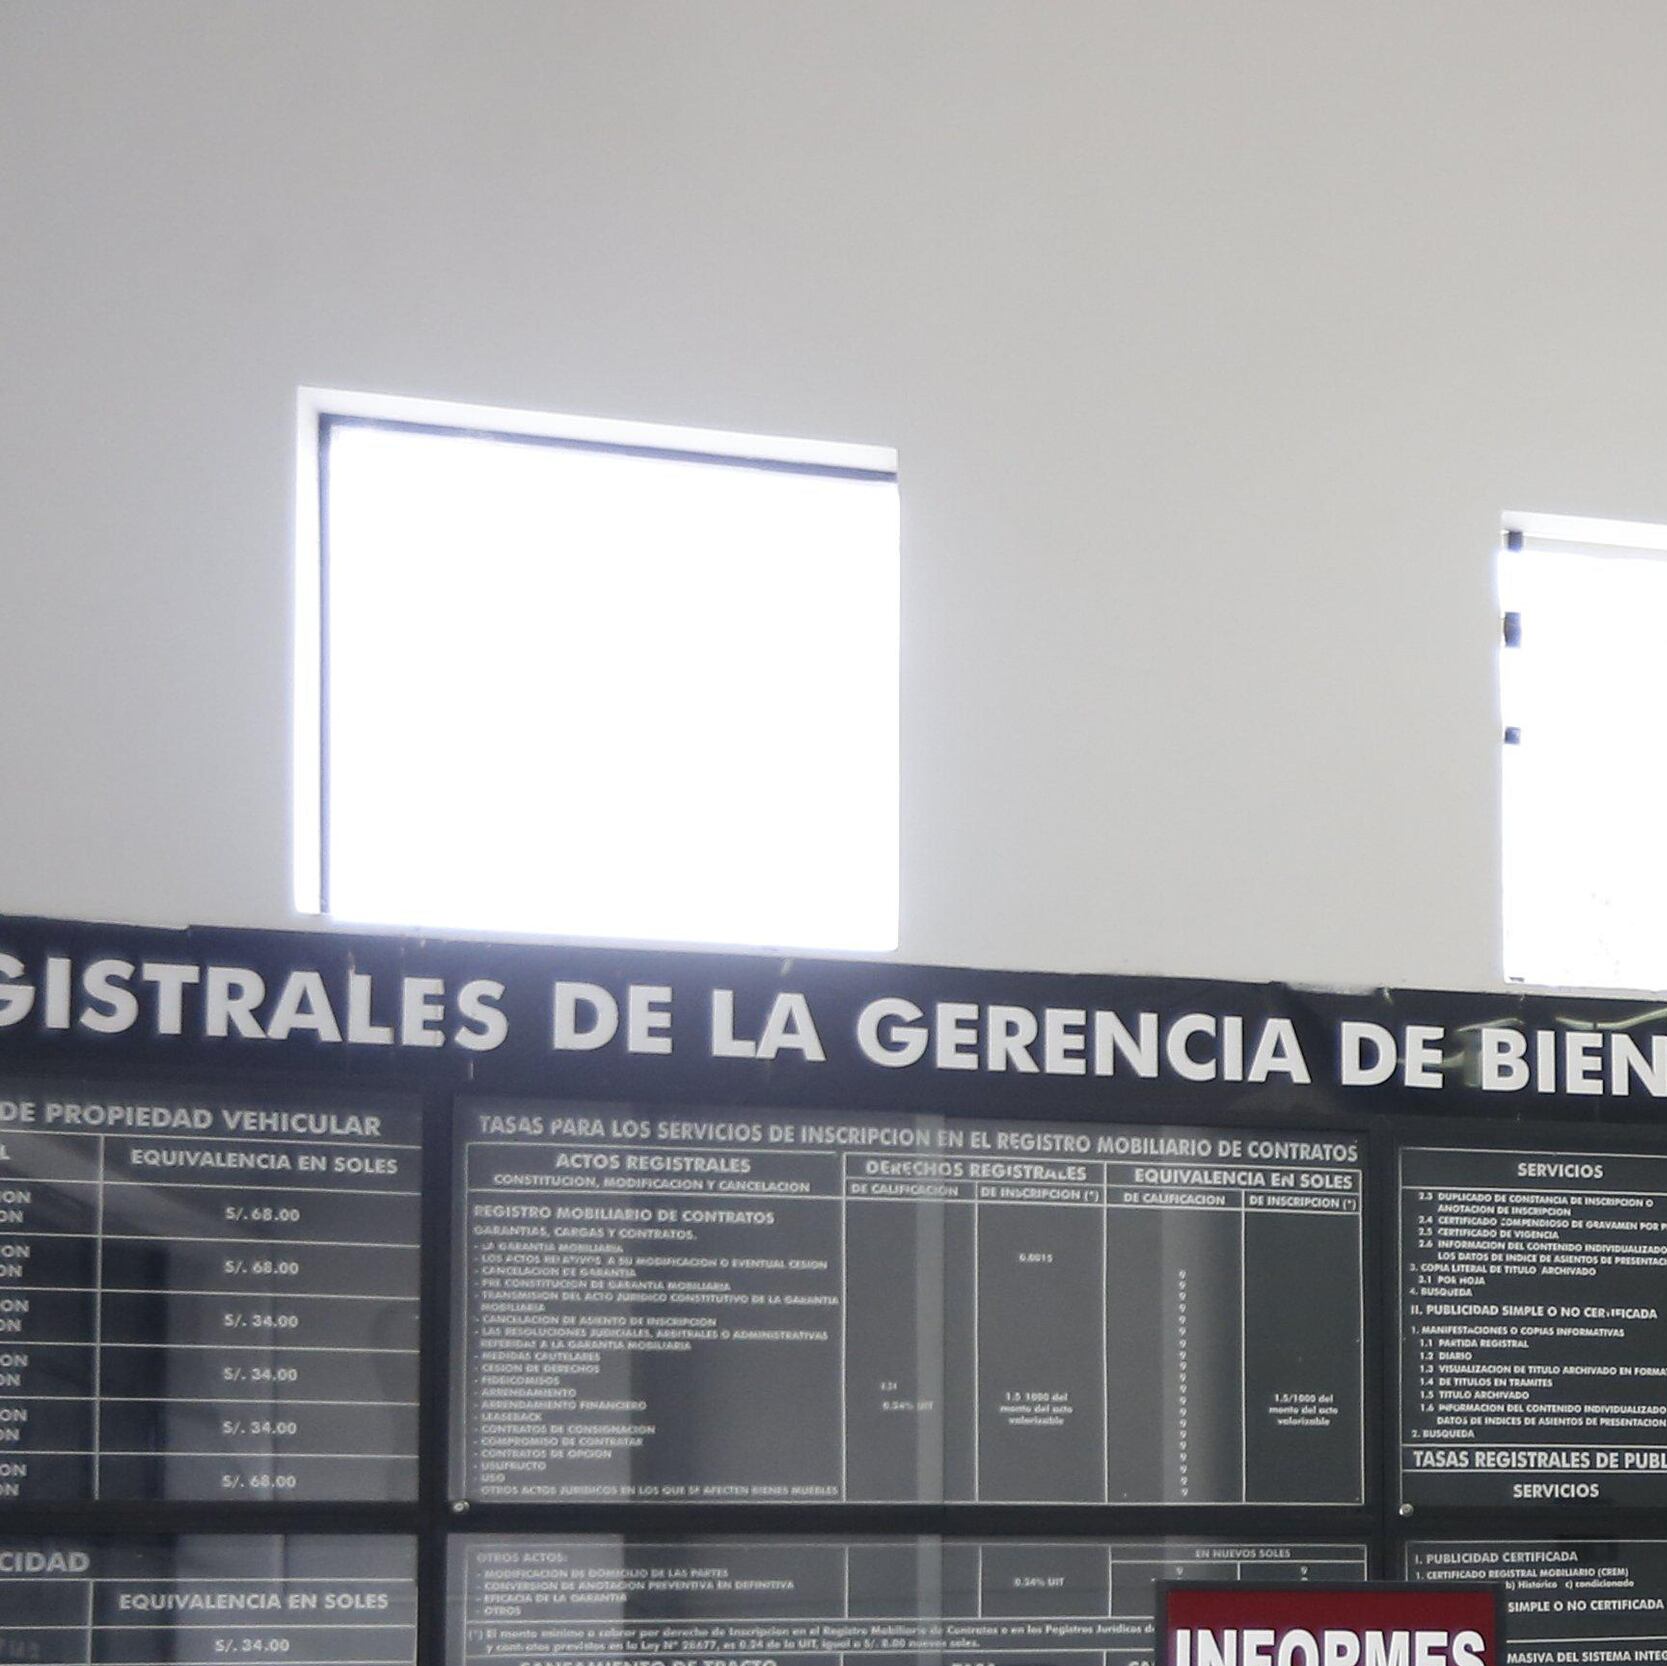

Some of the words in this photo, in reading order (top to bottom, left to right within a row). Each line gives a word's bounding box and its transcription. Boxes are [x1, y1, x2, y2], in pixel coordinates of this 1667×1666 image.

[554, 981, 670, 1052] DE
[712, 989, 822, 1060] LA
[856, 998, 1307, 1081] GERENCIA
[1341, 1021, 1443, 1087] DE
[0, 1102, 34, 1121] DE
[46, 1103, 211, 1128] PROPIEDAD
[223, 1110, 379, 1135] VEHICULAR
[481, 1116, 542, 1134] TASAS
[551, 1118, 604, 1135] PARA
[612, 1120, 649, 1138] LOS
[658, 1121, 761, 1141] SERVICIOS
[769, 1125, 793, 1142] DE
[801, 1126, 929, 1145] INSCRIPCION
[937, 1130, 962, 1146] EN
[970, 1131, 990, 1148] EL
[997, 1132, 1090, 1152] REGISTRO
[1097, 1136, 1211, 1155] MOBILIARIO
[1218, 1140, 1241, 1157] DE
[1247, 1141, 1357, 1161] CONTRATOS
[131, 1149, 290, 1168] EQUIVALENCIA
[298, 1155, 325, 1170] EN
[334, 1157, 396, 1173] SOLES
[1518, 1162, 1602, 1178] SERVICIOS
[1426, 1304, 1498, 1315] PUBLICIDAD
[1502, 1305, 1543, 1316] SIMPLE
[1560, 1306, 1580, 1317] NO
[1583, 1307, 1657, 1318] CERTIFICADA
[1414, 1451, 1468, 1469] TASAS
[1475, 1451, 1590, 1469] REGISTRALES
[1597, 1453, 1621, 1469] DE
[1507, 1652, 1553, 1663] MASIVA
[1557, 1652, 1578, 1662] DEL
[1582, 1651, 1630, 1661] SISTEMA
